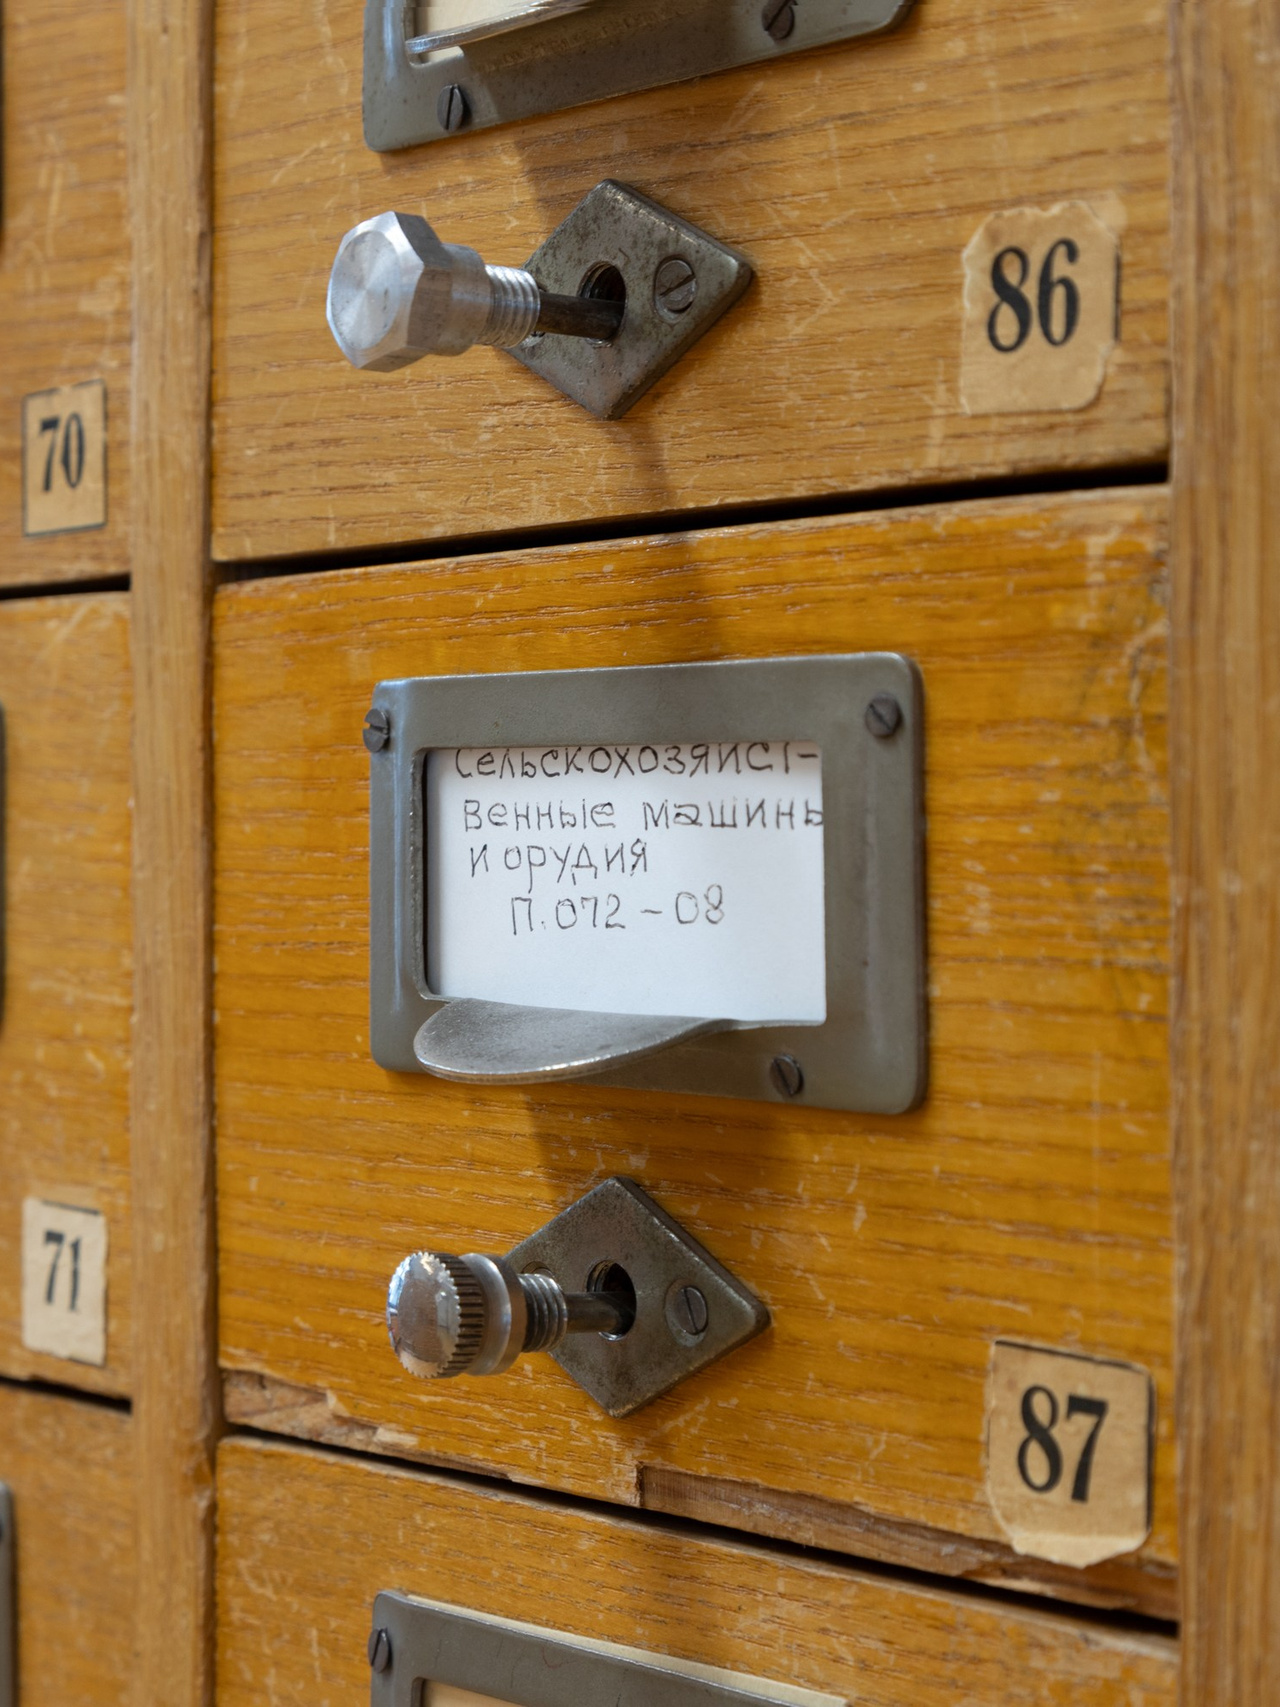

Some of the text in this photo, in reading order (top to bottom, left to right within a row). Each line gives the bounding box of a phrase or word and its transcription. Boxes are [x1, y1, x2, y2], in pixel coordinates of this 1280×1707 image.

[987, 238, 1080, 353] 86
[38, 412, 85, 493] 70
[504, 838, 647, 894] орудия
[43, 1230, 81, 1312] 71
[1017, 1384, 1109, 1504] 87
